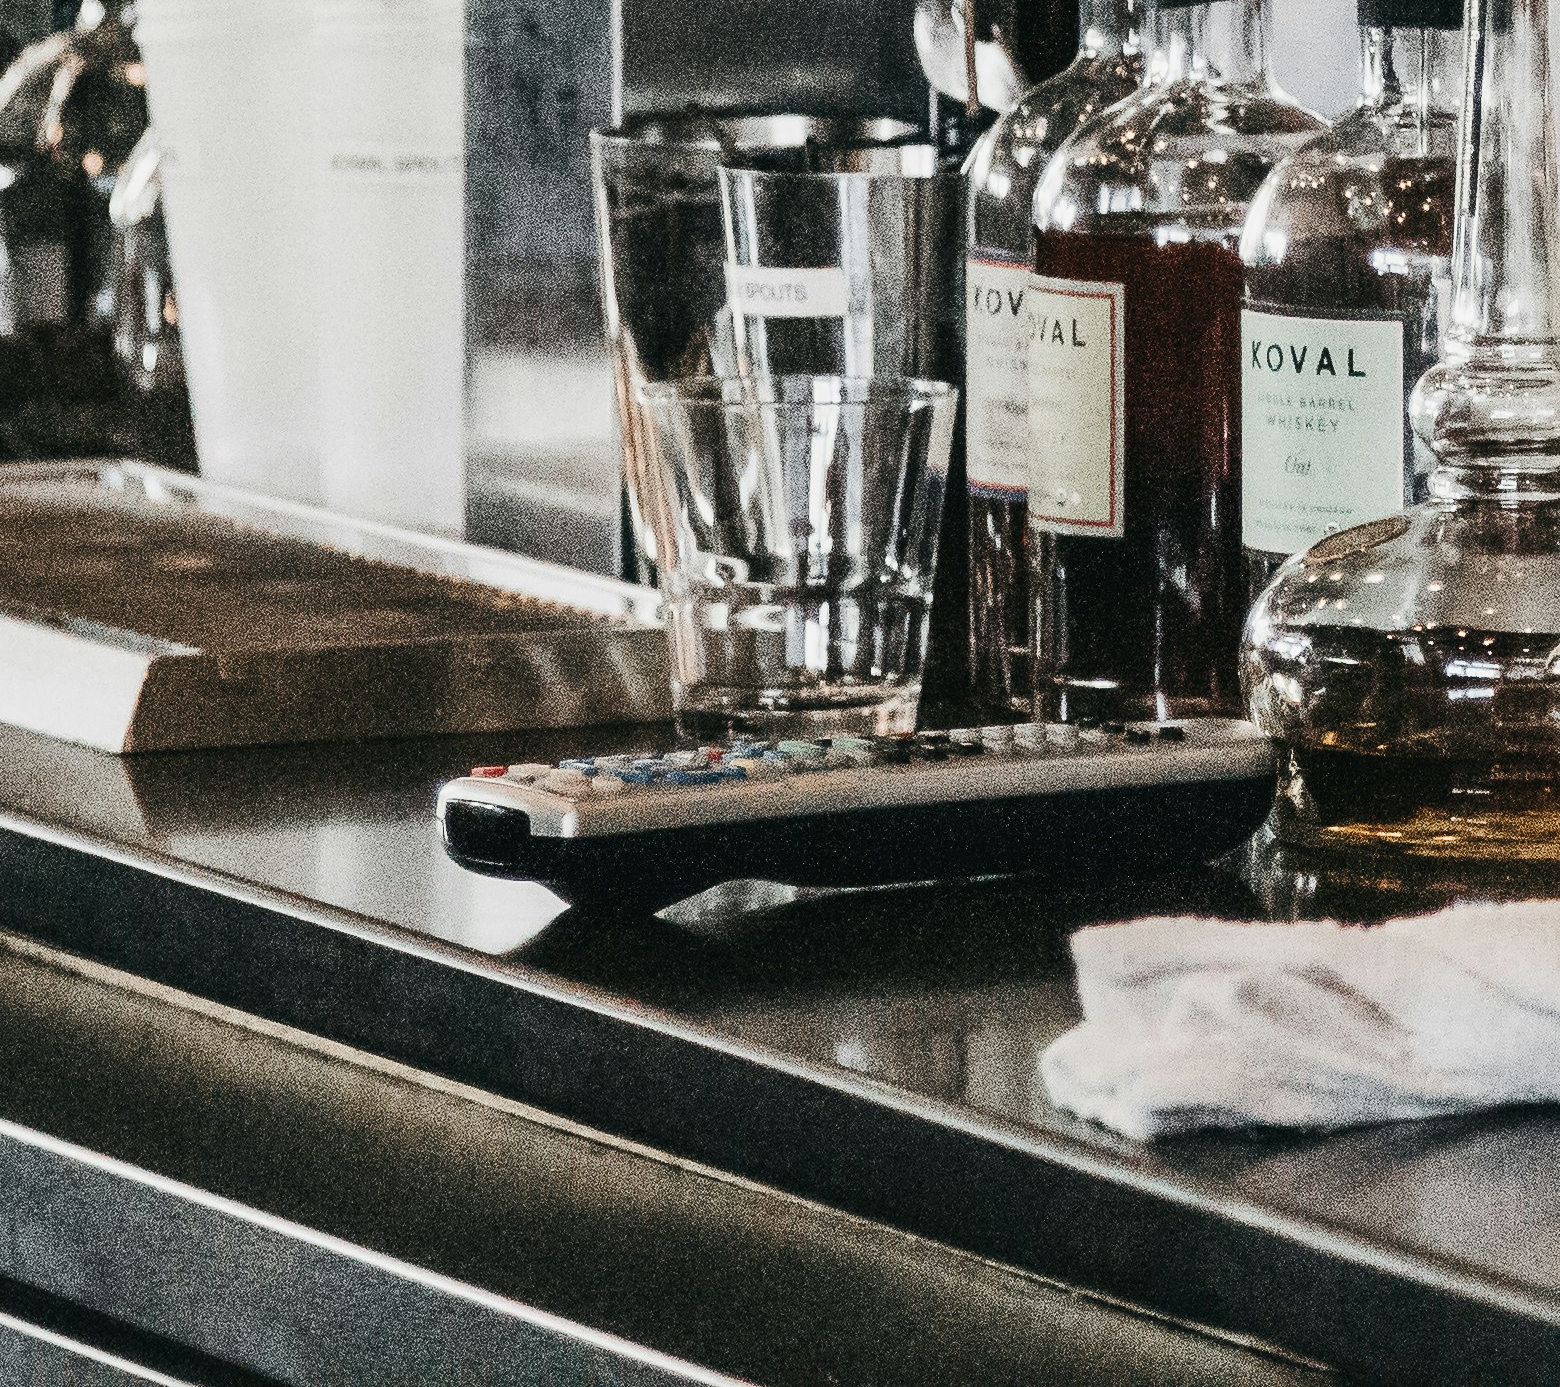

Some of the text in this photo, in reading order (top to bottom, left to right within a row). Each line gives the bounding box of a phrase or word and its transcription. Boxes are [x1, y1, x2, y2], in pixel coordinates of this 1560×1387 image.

[973, 287, 1024, 317] KOV
[1029, 314, 1087, 348] VAL
[1251, 339, 1368, 379] KOVAL
[1266, 414, 1340, 434] WHISKEY
